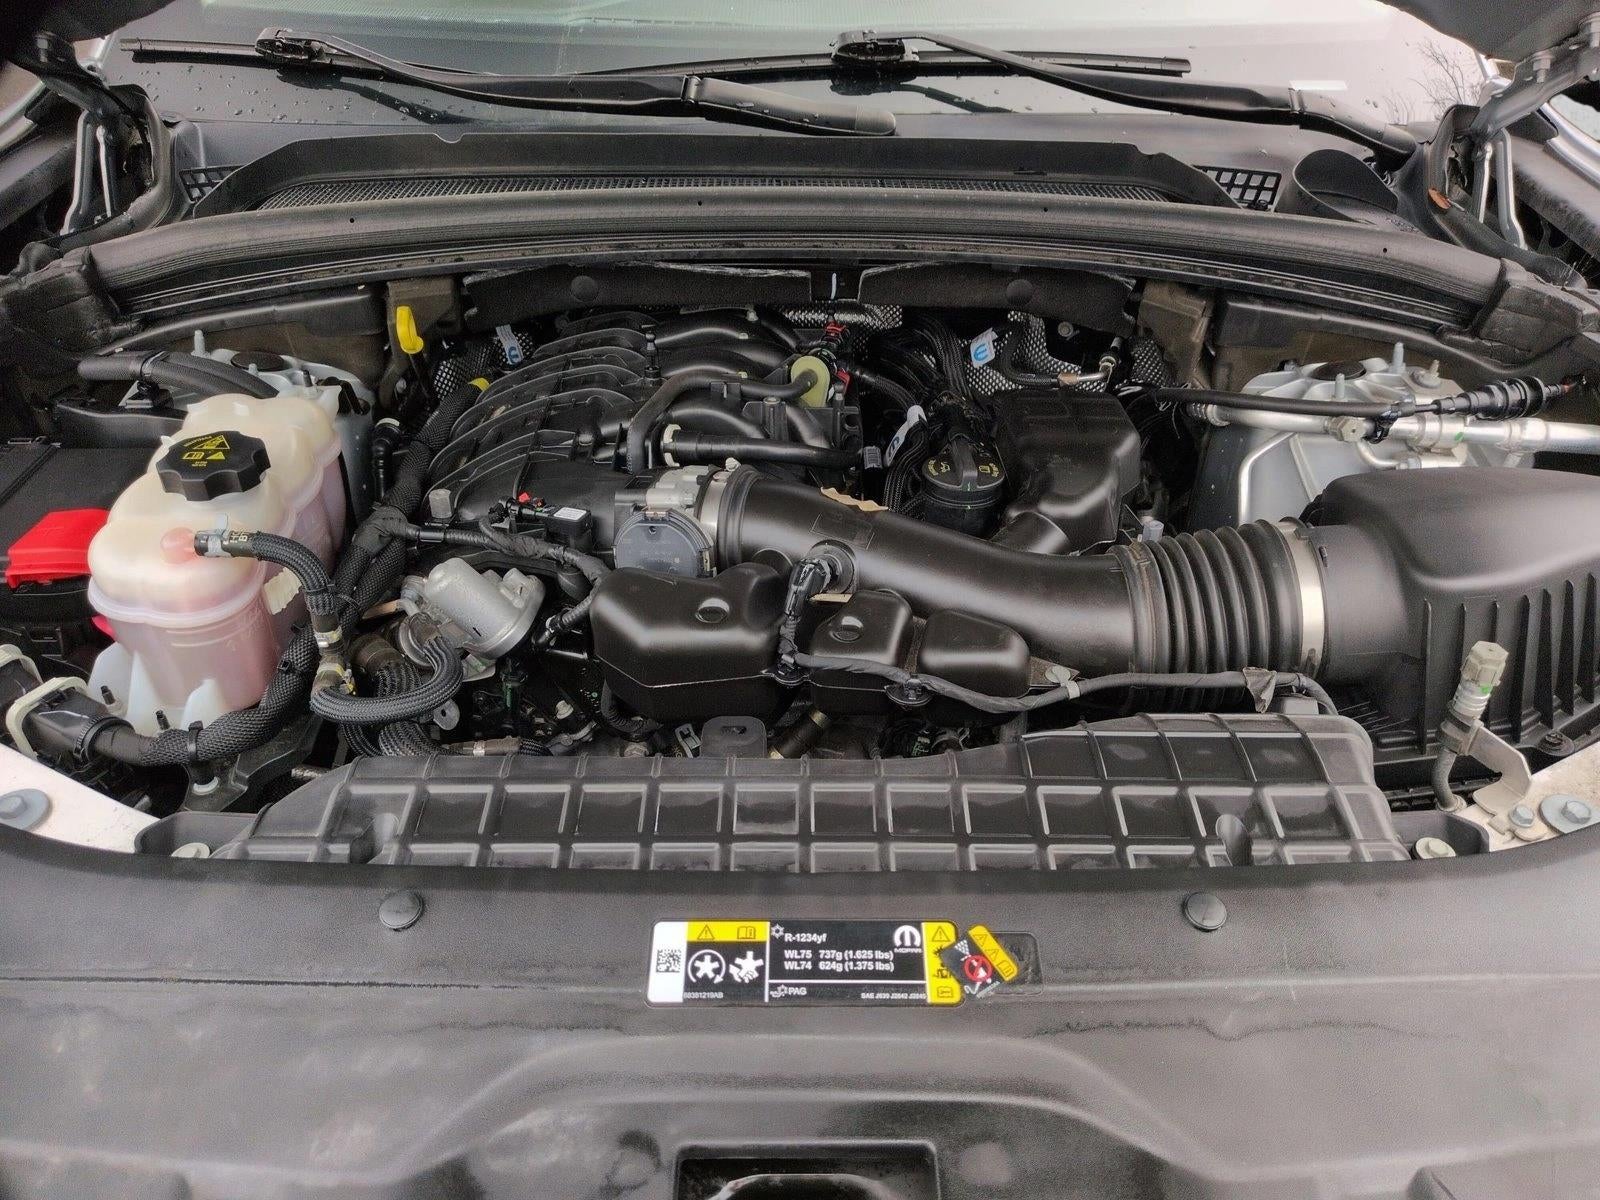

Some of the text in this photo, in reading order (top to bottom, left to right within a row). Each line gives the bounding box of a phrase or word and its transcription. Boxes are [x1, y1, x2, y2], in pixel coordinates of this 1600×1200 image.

[784, 933, 827, 944] R-1234yf
[784, 950, 894, 961] WL75 737g (1.625 lbs)
[784, 961, 895, 972] WL74 624g (1.375 lbs)
[788, 987, 807, 996] PAG
